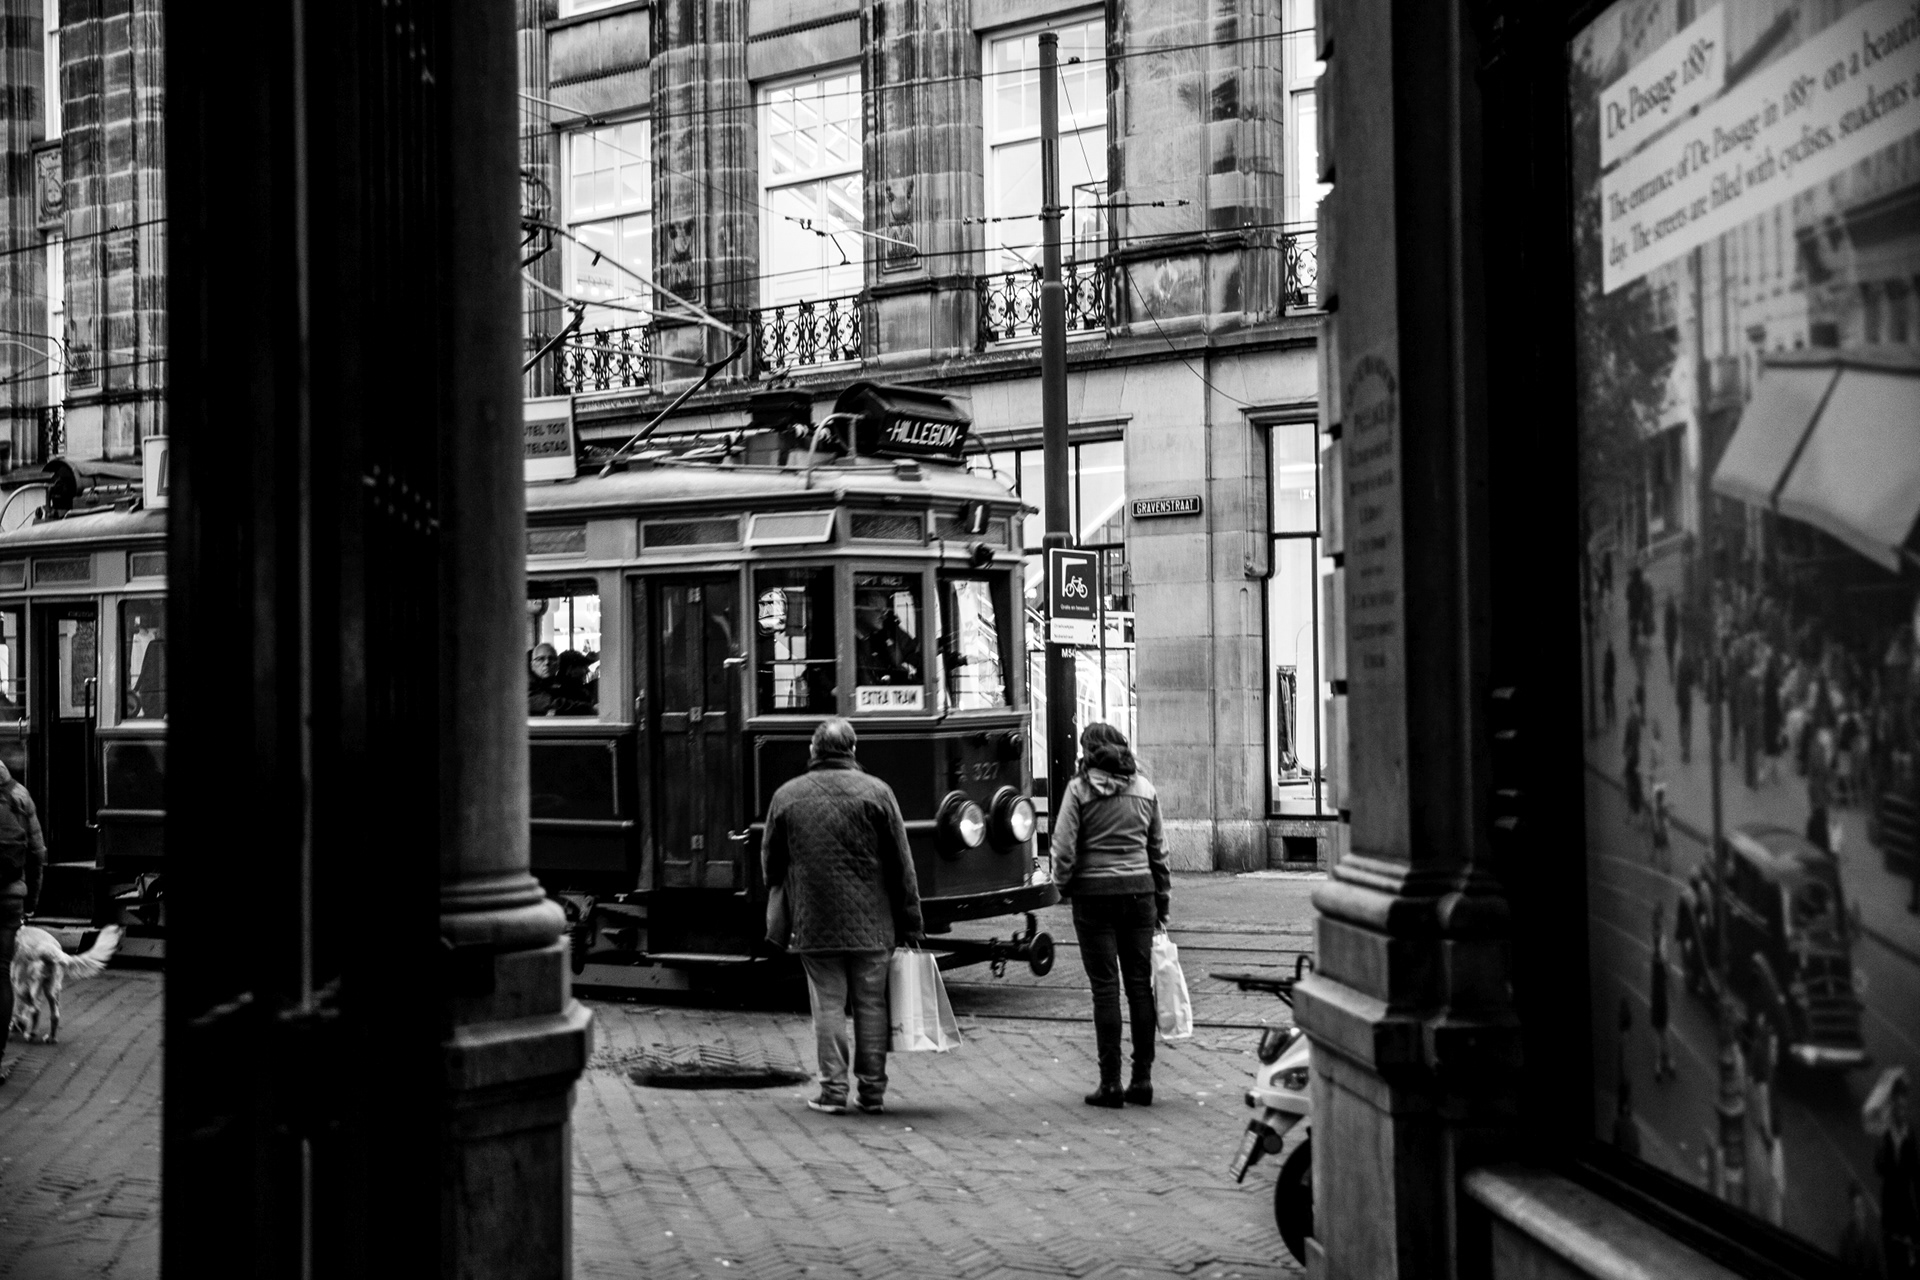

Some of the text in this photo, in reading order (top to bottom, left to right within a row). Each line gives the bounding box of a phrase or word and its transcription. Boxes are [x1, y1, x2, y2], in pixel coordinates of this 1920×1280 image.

[1607, 101, 1625, 139] De
[1629, 70, 1677, 124] Passage
[1608, 191, 1627, 222] The
[1692, 139, 1709, 171] De
[1713, 114, 1759, 158] Passage
[1763, 98, 1778, 128] in
[1823, 60, 1846, 91] on
[1849, 51, 1860, 76] a
[1631, 221, 1650, 253] The
[1654, 206, 1687, 242] streets
[1690, 195, 1708, 222] are
[1711, 163, 1743, 210] filled
[1745, 145, 1776, 188] with
[1136, 499, 1194, 514] GRAVENSTRAAT
[972, 761, 999, 781] 327
